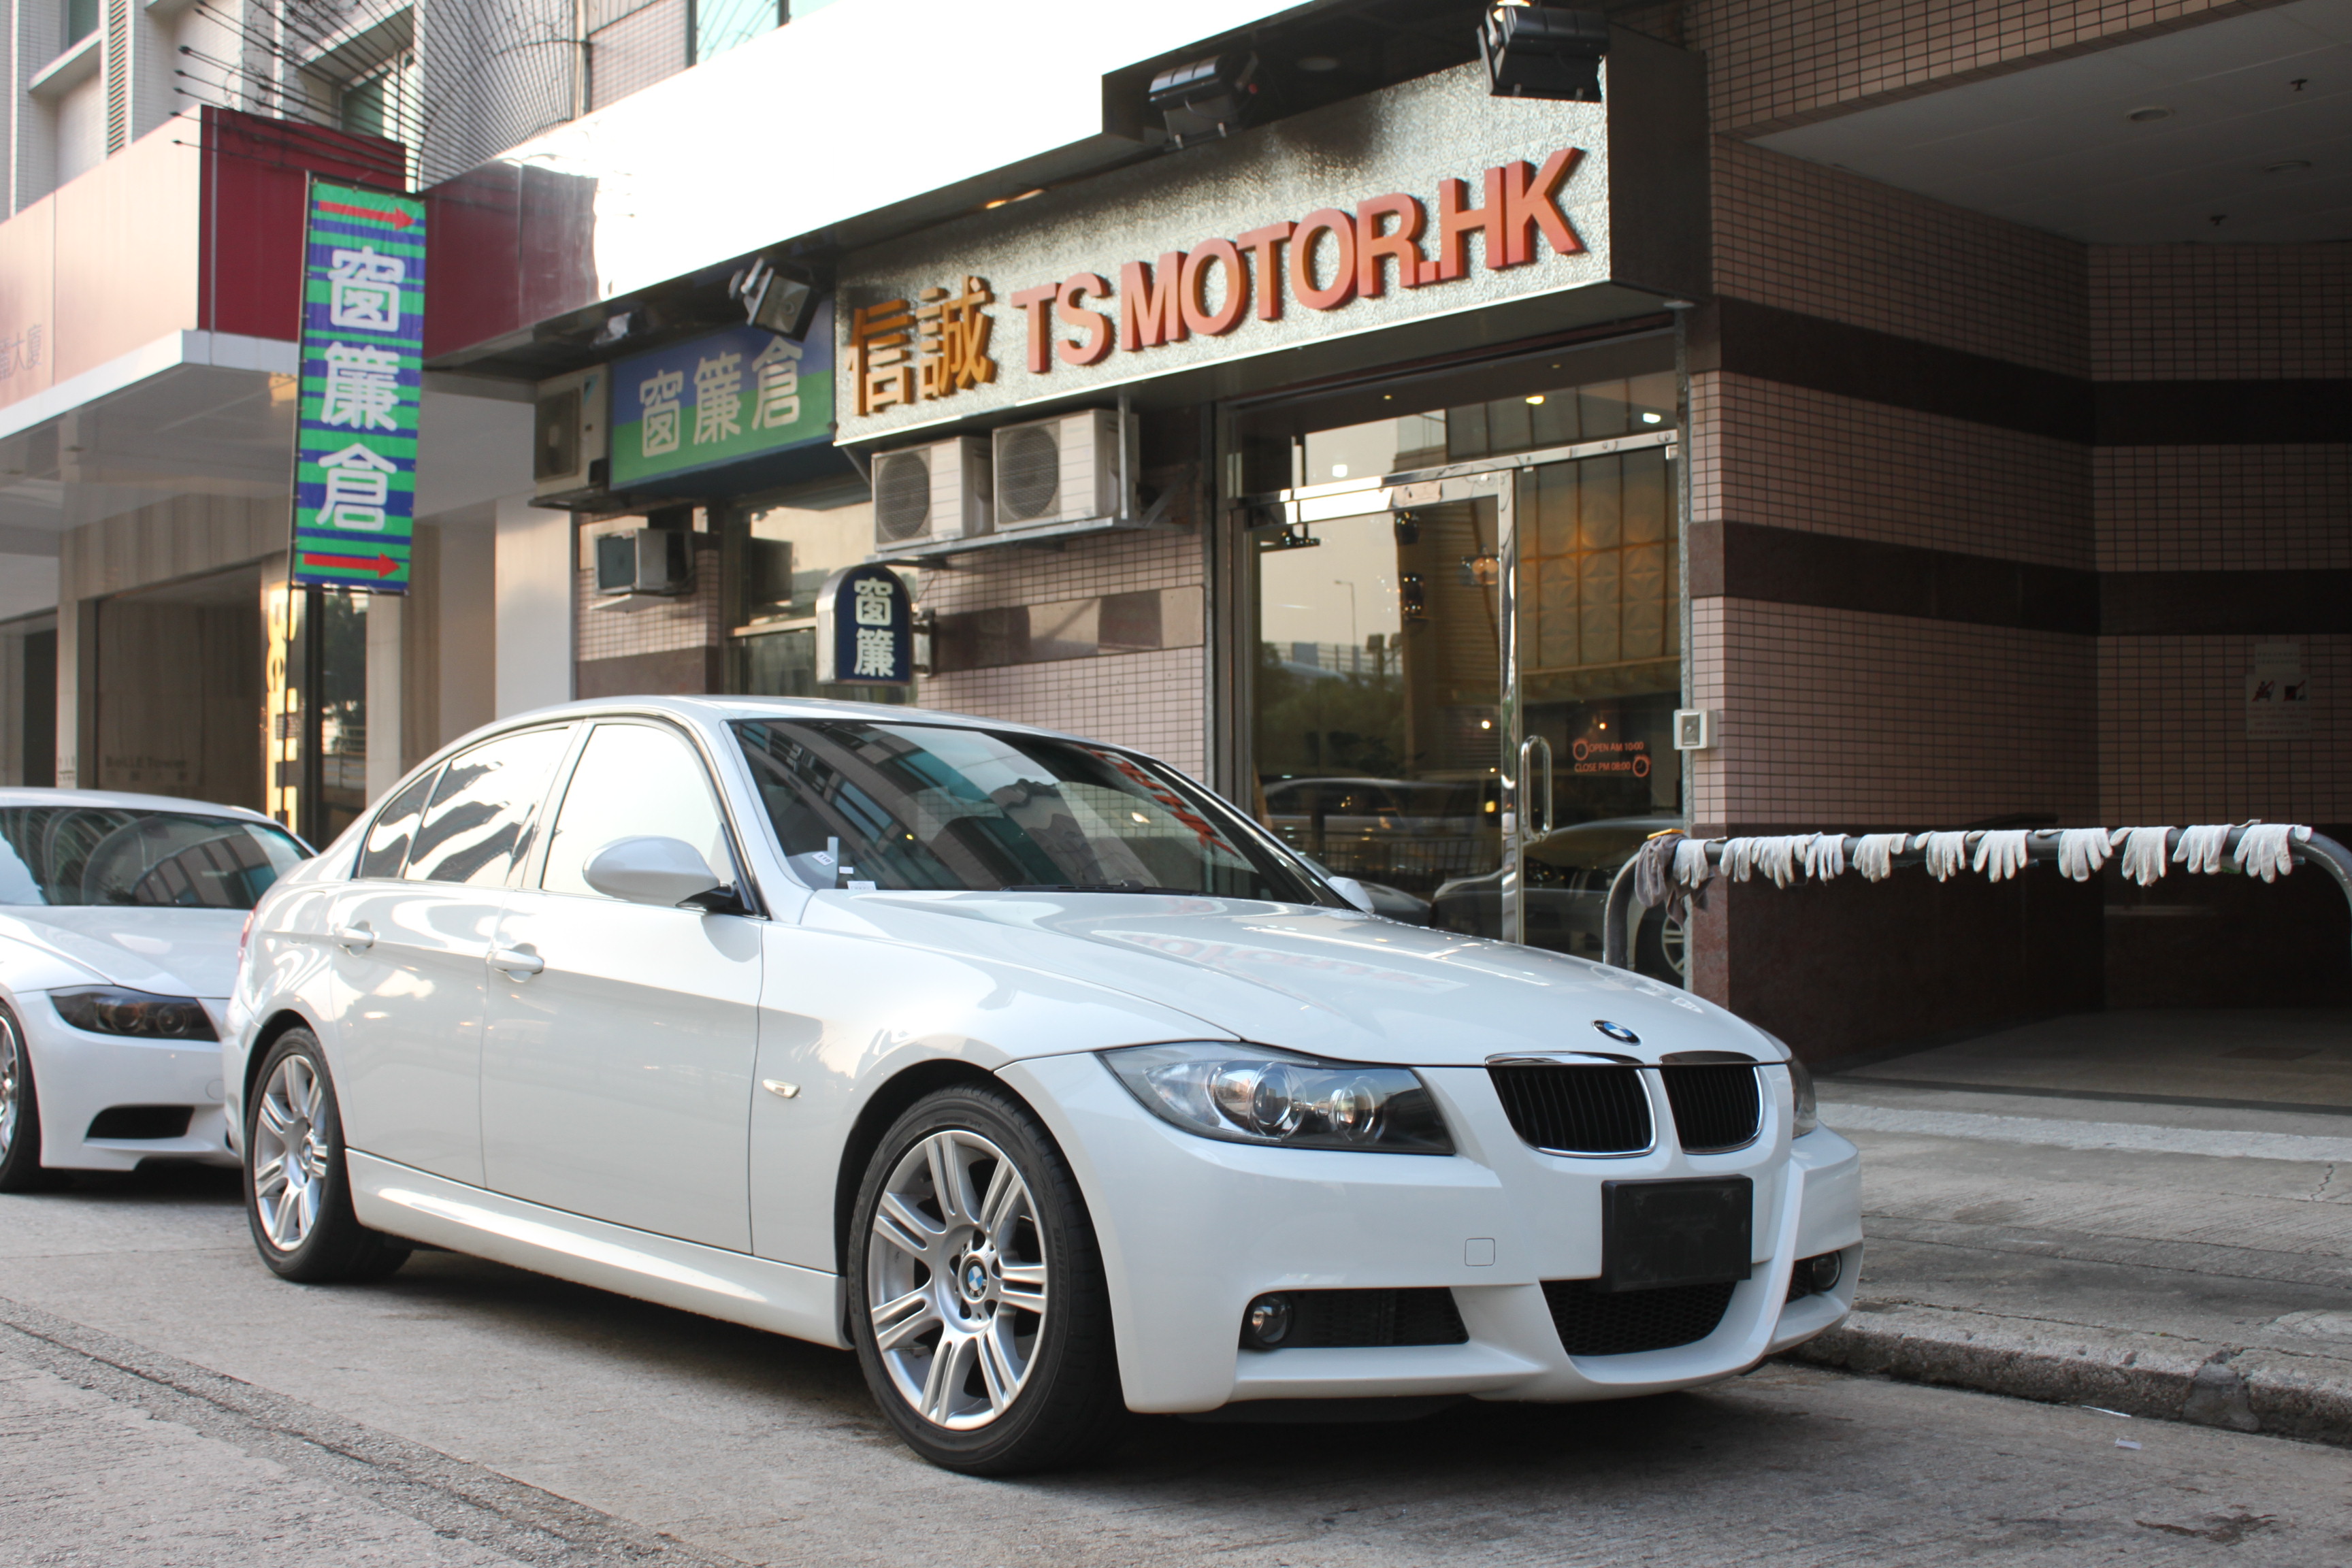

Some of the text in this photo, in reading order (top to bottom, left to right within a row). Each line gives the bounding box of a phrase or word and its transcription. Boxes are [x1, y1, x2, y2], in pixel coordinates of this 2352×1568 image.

[843, 146, 1586, 416] 信誠 TS MOTOR.HK
[315, 246, 406, 531] 窗簾倉
[640, 336, 802, 458] 窗簾倉
[853, 576, 896, 677] 窗簾
[1574, 762, 1597, 773] CLOSE
[1598, 762, 1610, 771] PM
[1589, 742, 1610, 753] OPEN
[1610, 742, 1624, 752] AM
